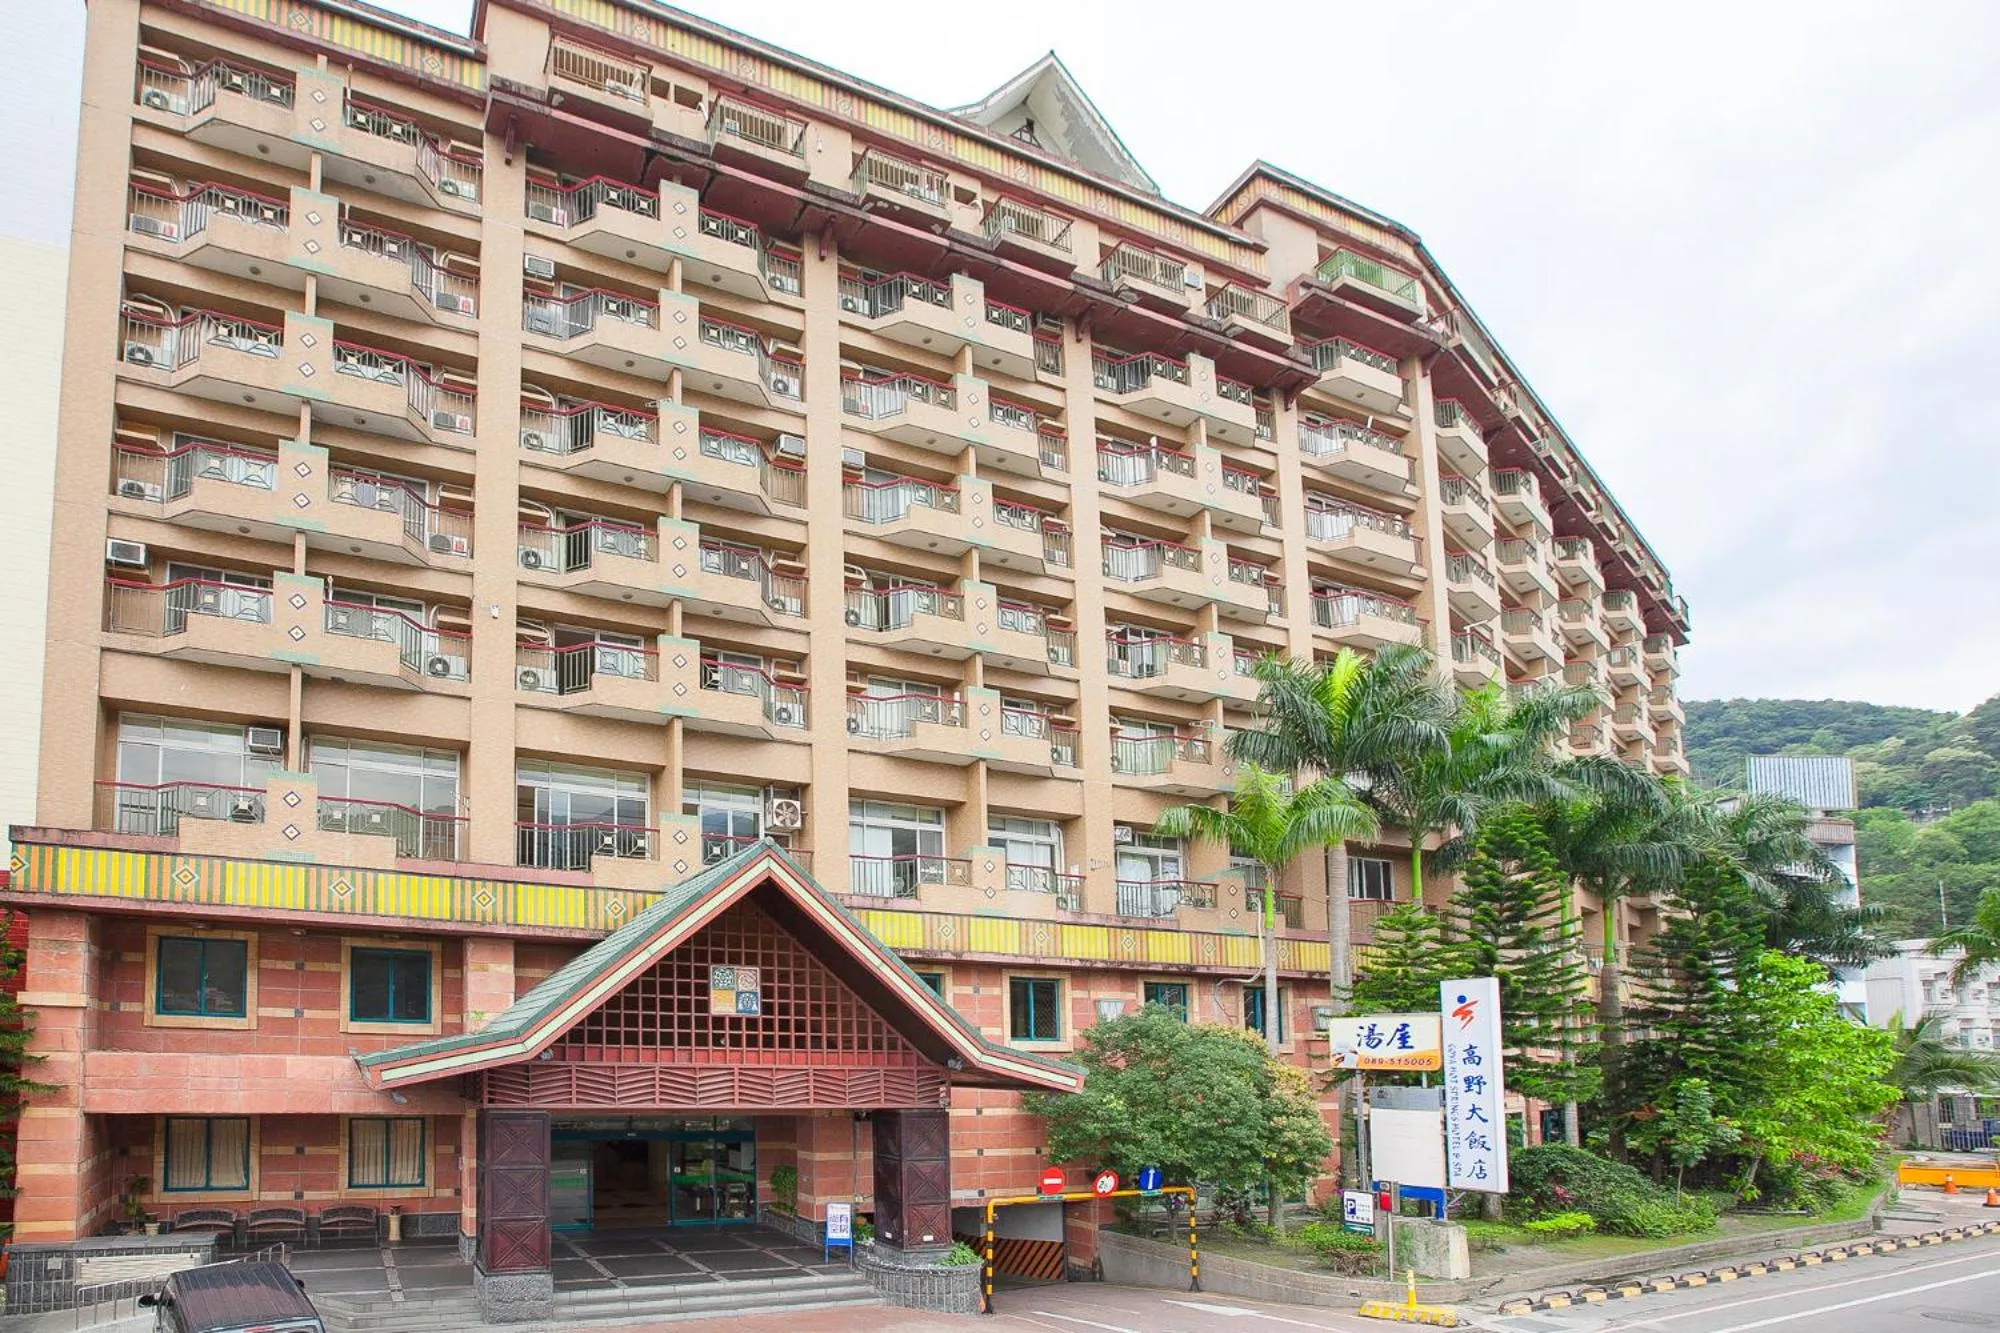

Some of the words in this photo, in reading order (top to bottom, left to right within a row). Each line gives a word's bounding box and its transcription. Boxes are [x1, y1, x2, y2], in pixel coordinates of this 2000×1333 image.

[1357, 1023, 1414, 1049] 湯屋
[1364, 1057, 1432, 1066] 089-515005
[1462, 1044, 1491, 1179] 高野大飯店
